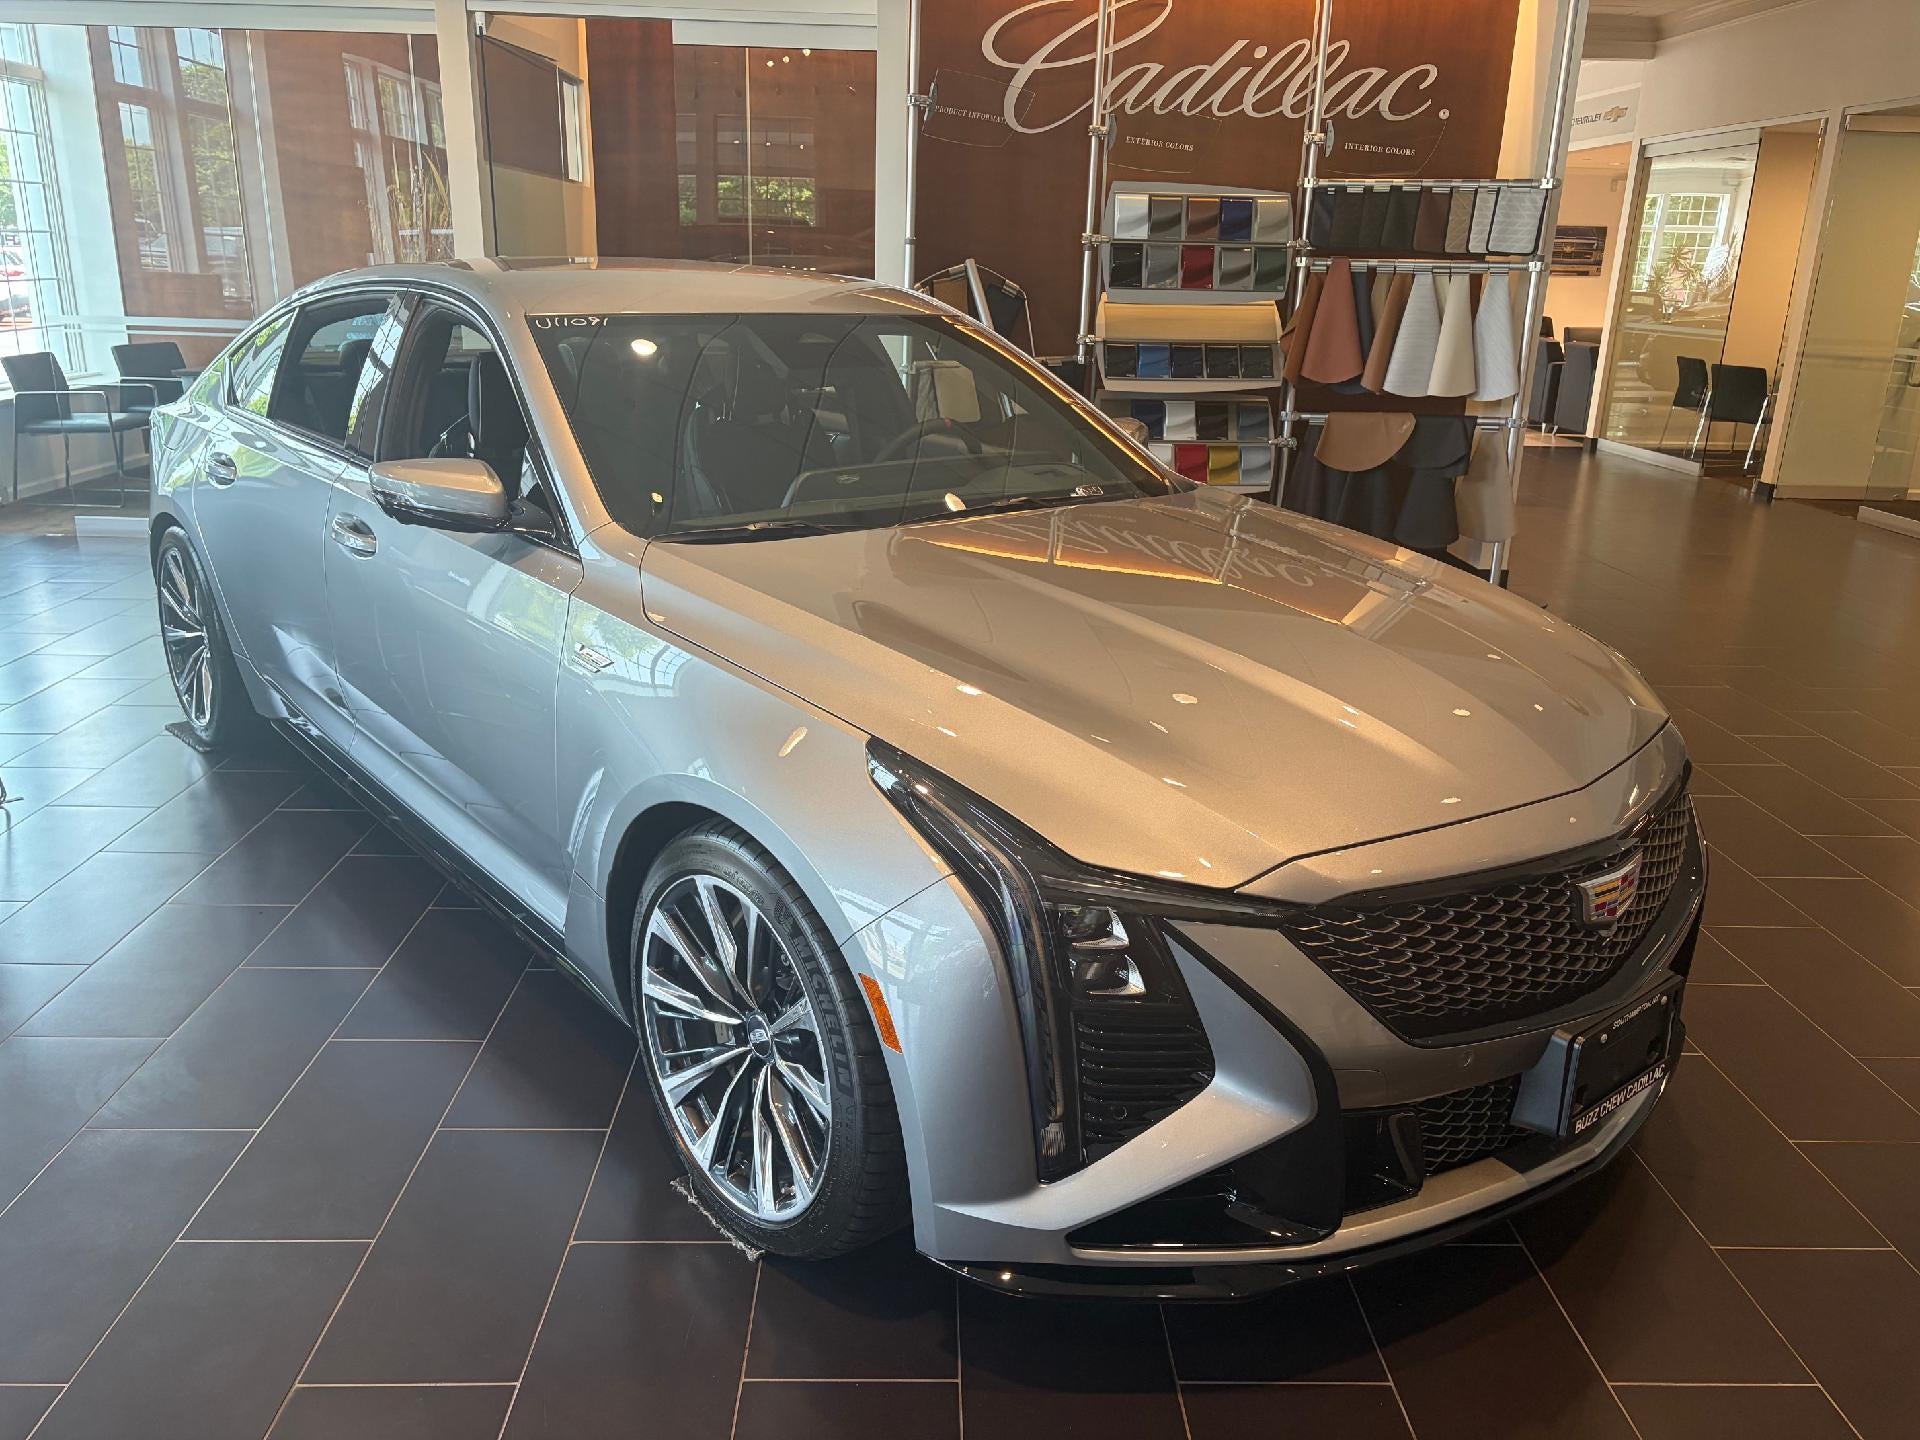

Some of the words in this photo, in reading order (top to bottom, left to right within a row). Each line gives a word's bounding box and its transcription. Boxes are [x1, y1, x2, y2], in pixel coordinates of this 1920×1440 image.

[1125, 136, 1163, 148] EXTERIOR
[1165, 141, 1194, 151] COLORS
[1344, 142, 1384, 153] INTERIOR
[1385, 147, 1415, 156] COLORS
[795, 936, 851, 1091] MICHELIN
[1574, 1107, 1600, 1134] BUZZ
[1600, 1088, 1627, 1118] CHEW
[1626, 1063, 1666, 1099] CADILLAC
